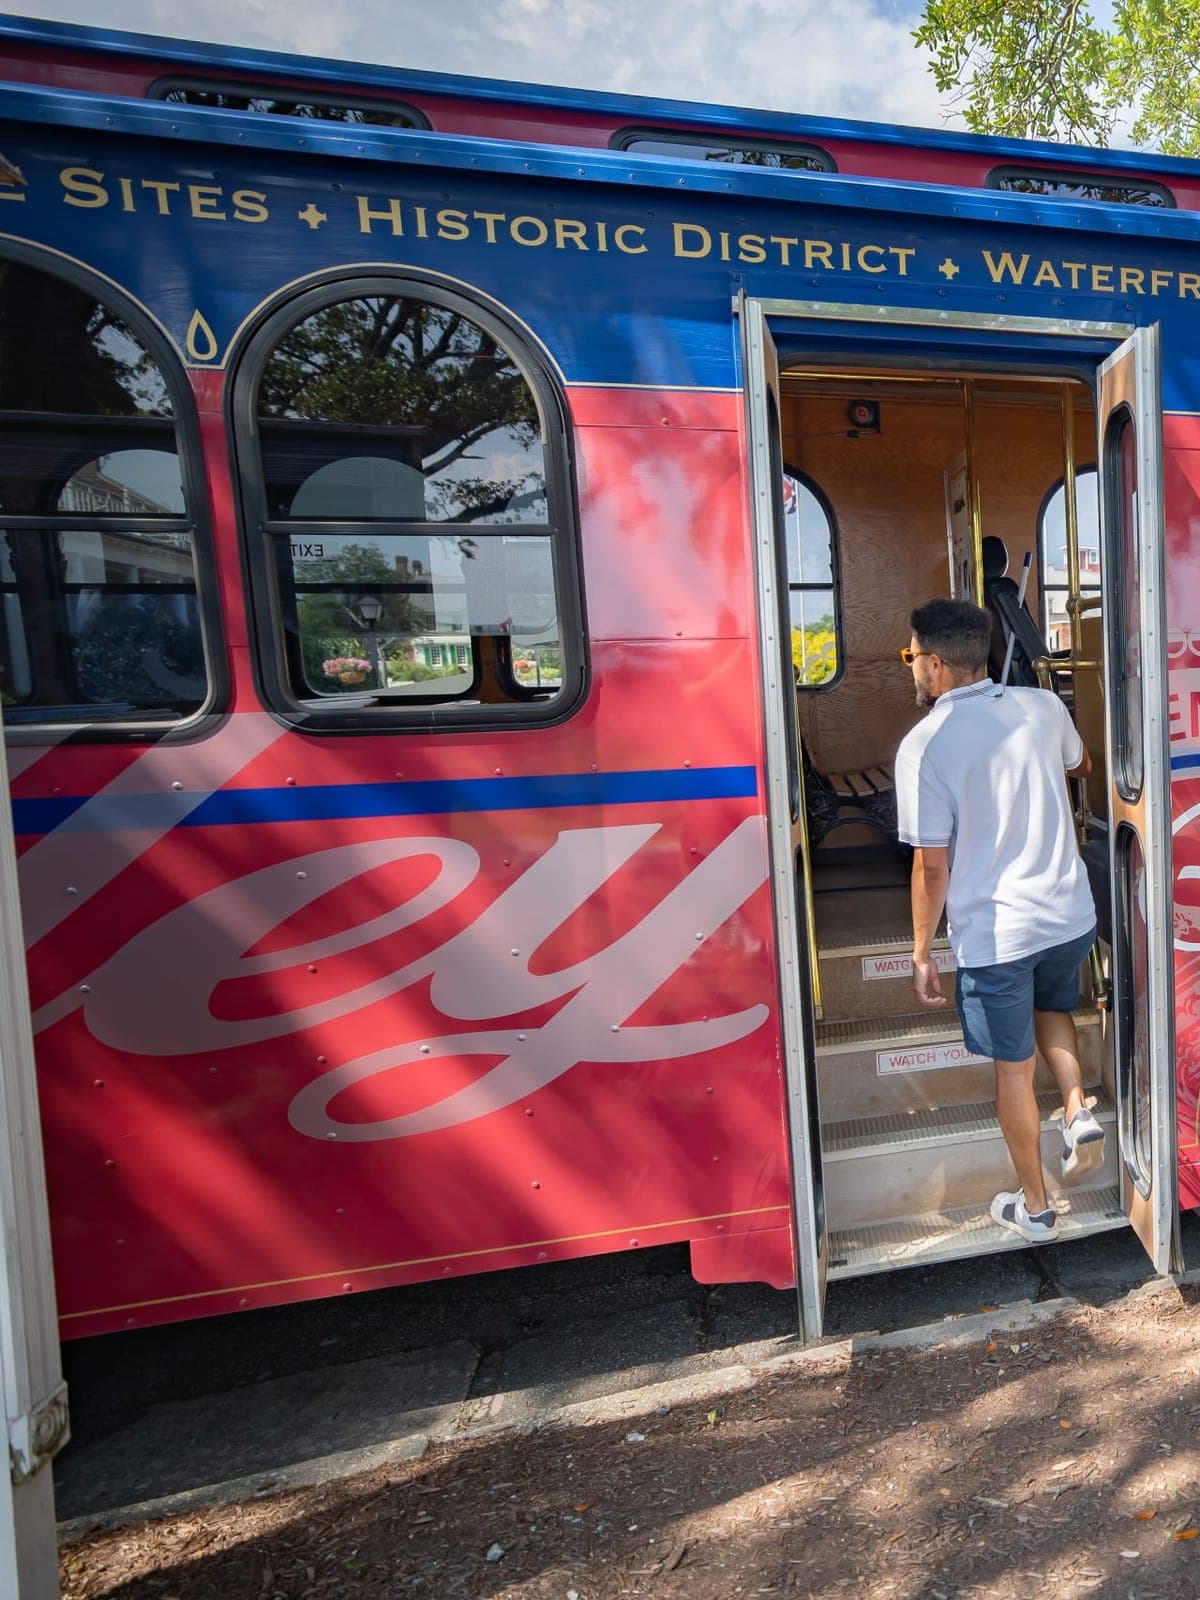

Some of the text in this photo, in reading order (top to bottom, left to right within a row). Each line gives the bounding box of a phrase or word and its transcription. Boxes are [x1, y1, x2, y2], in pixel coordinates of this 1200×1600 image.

[59, 166, 270, 224] SITES
[356, 196, 649, 254] HISTORIC
[671, 222, 916, 276] DISTRICT
[875, 959, 914, 973] WATC
[889, 1047, 977, 1067] WATCH YOU
